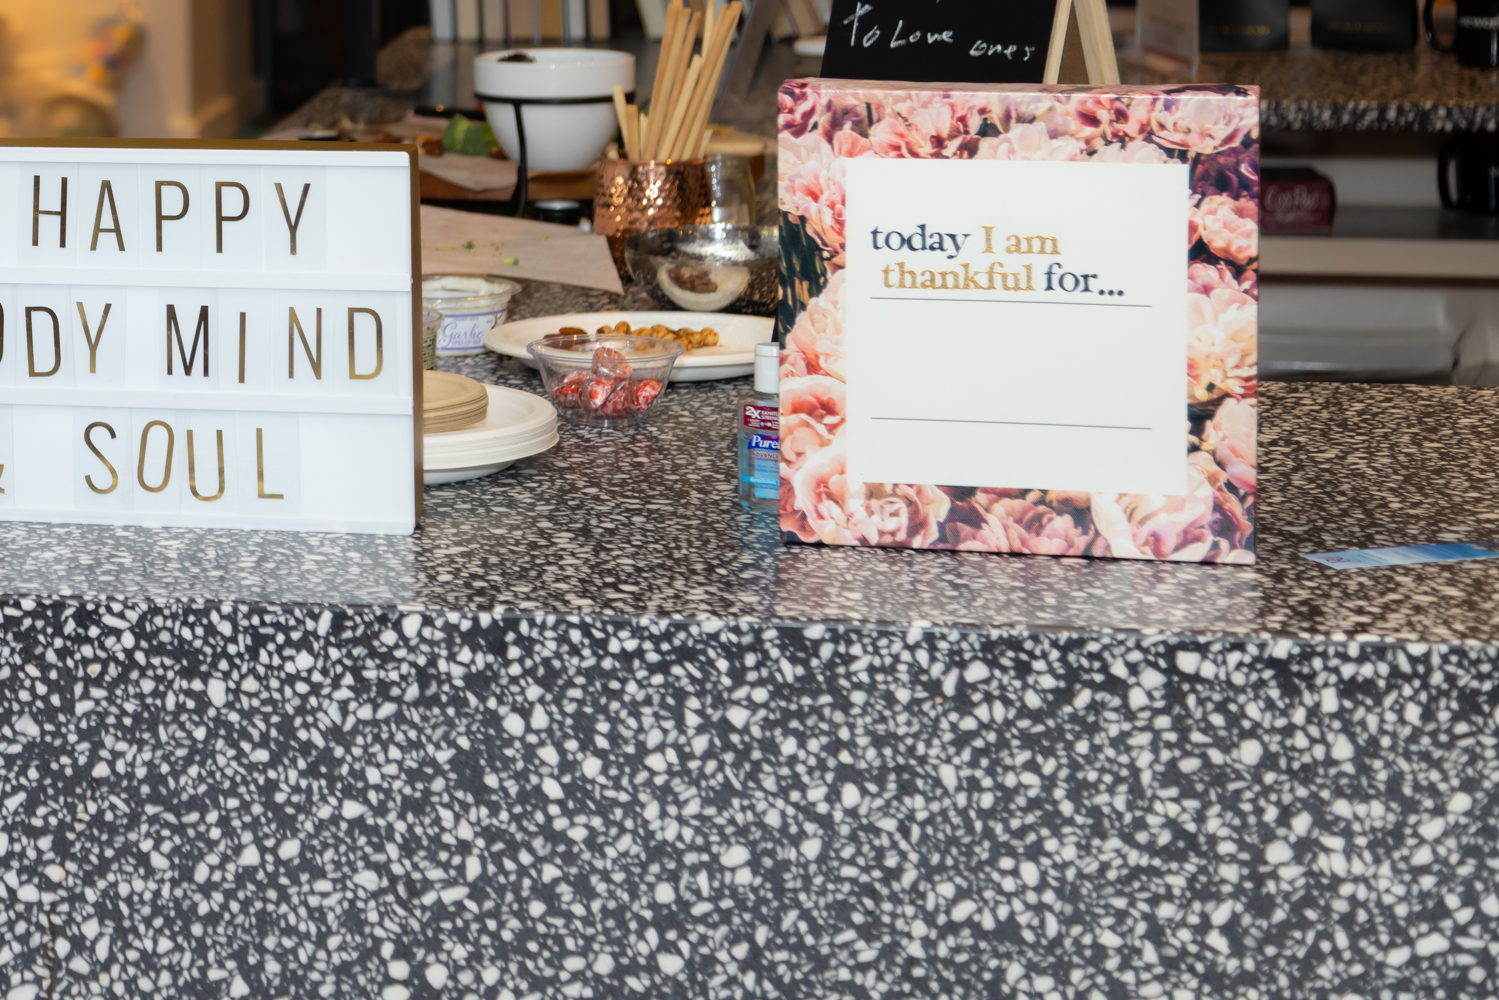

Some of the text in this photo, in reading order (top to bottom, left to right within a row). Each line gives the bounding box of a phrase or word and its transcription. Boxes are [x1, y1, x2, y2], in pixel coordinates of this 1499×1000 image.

[889, 19, 954, 48] Love
[31, 174, 312, 256] HAPPY
[870, 223, 1062, 260] today I am
[881, 260, 1125, 297] thankful for...
[166, 303, 384, 384] MIND
[438, 321, 485, 348] Garlic
[751, 434, 780, 449] Pure
[83, 420, 285, 502] SOUL
